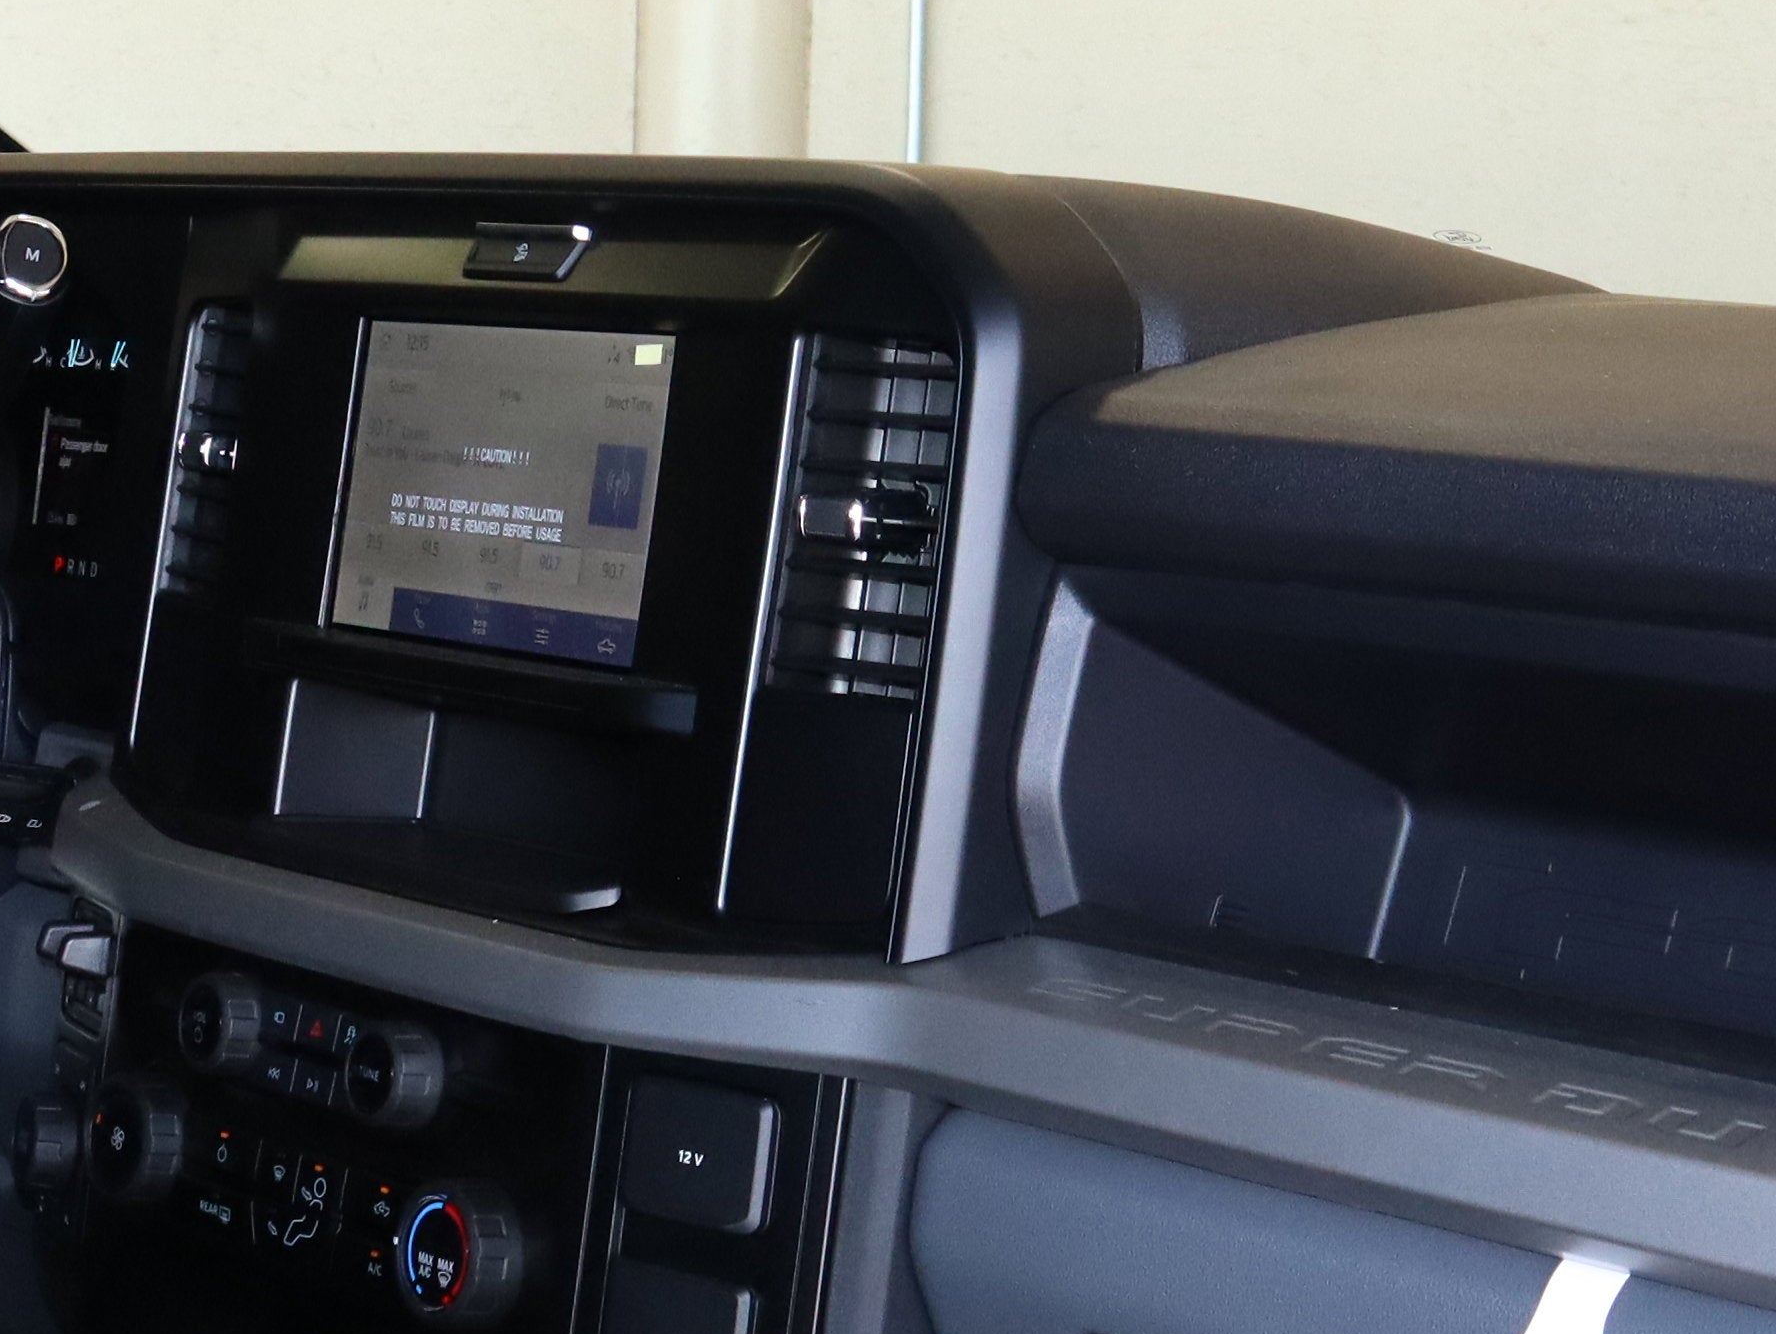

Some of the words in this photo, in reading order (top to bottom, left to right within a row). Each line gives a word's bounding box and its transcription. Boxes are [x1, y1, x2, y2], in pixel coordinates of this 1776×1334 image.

[25, 247, 41, 262] M
[391, 492, 403, 507] DO
[405, 494, 420, 508] NOT
[422, 496, 447, 511] TOUCH
[448, 498, 479, 515] DISPLAY
[481, 502, 509, 518] DURING
[511, 505, 565, 524] INSTALLATION
[389, 510, 406, 526] THIS
[407, 512, 424, 527] FILM
[426, 514, 435, 529] IS
[437, 516, 448, 530] TO
[450, 517, 461, 532] BE
[463, 518, 500, 536] REMOVED
[502, 523, 532, 539] BEFORE
[535, 526, 562, 543] USAGE
[54, 555, 65, 574] P
[67, 558, 75, 574] R
[78, 560, 86, 576] N
[90, 561, 98, 578] D
[359, 1065, 380, 1083] TUNE
[678, 1149, 693, 1165] 12
[694, 1153, 704, 1167] V
[418, 1251, 434, 1267] MAX
[437, 1257, 455, 1274] MAX
